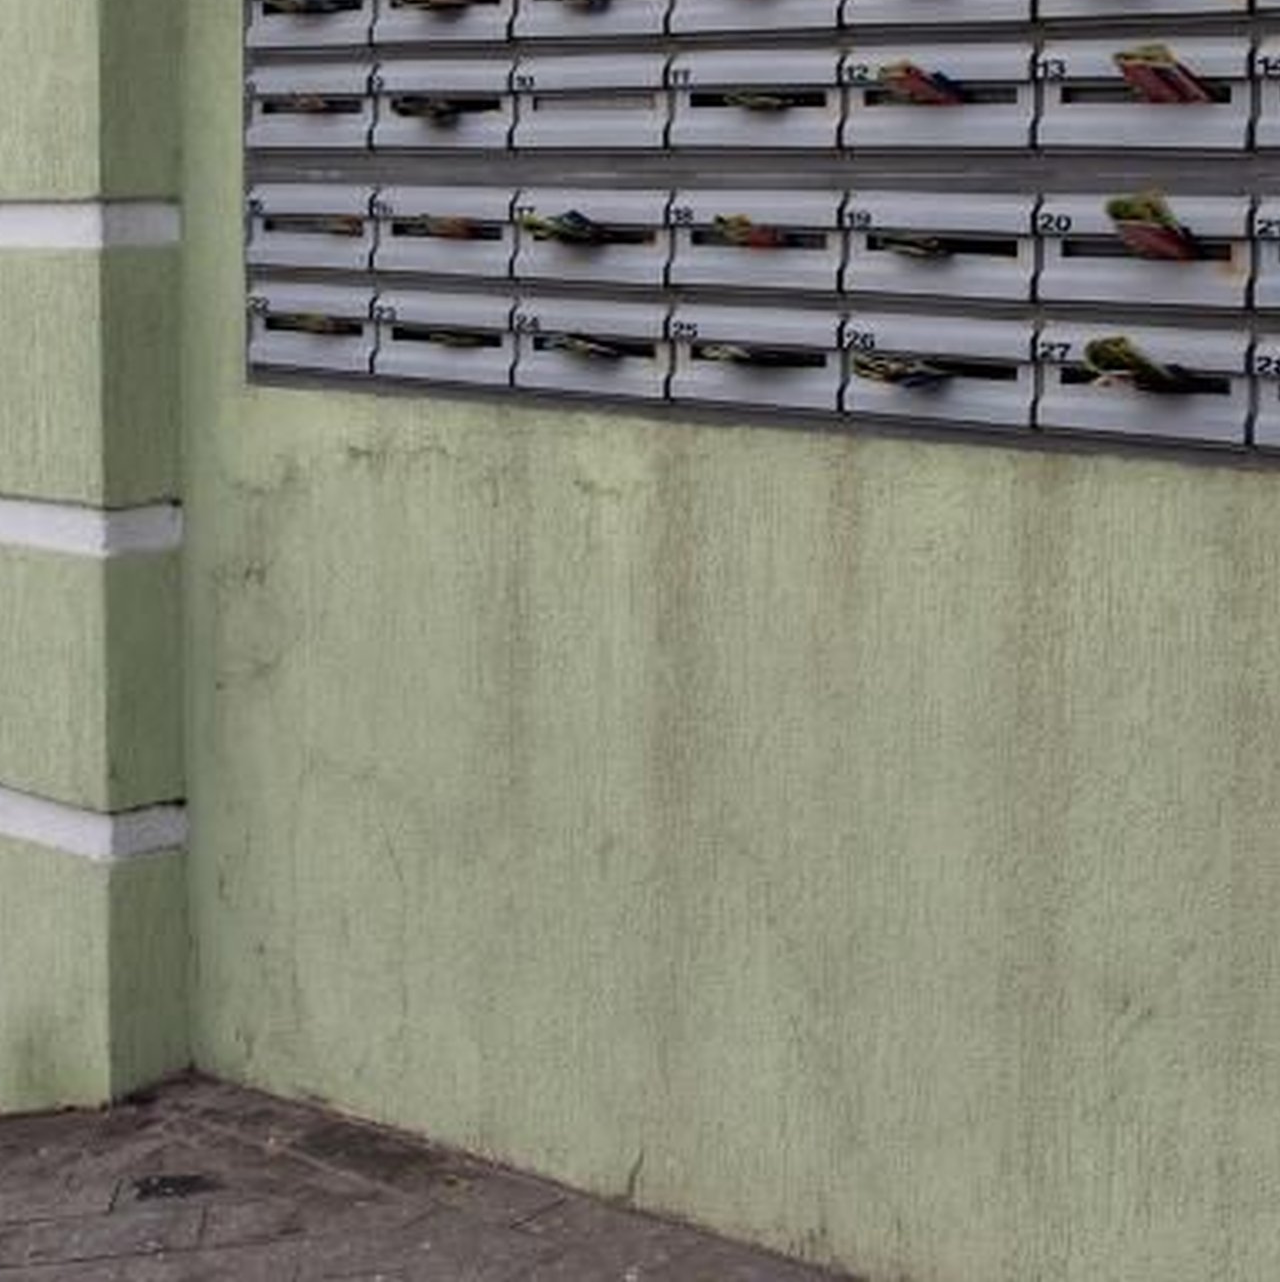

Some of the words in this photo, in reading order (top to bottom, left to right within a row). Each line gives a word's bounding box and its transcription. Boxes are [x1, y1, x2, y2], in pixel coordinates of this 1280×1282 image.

[671, 69, 691, 85] 11
[845, 64, 869, 81] 12
[1038, 59, 1066, 78] 13
[845, 210, 872, 226] 19
[1040, 212, 1072, 233] 20
[515, 313, 540, 332] 24
[671, 320, 697, 339] 25
[845, 330, 876, 350] 26
[1040, 340, 1072, 361] 27
